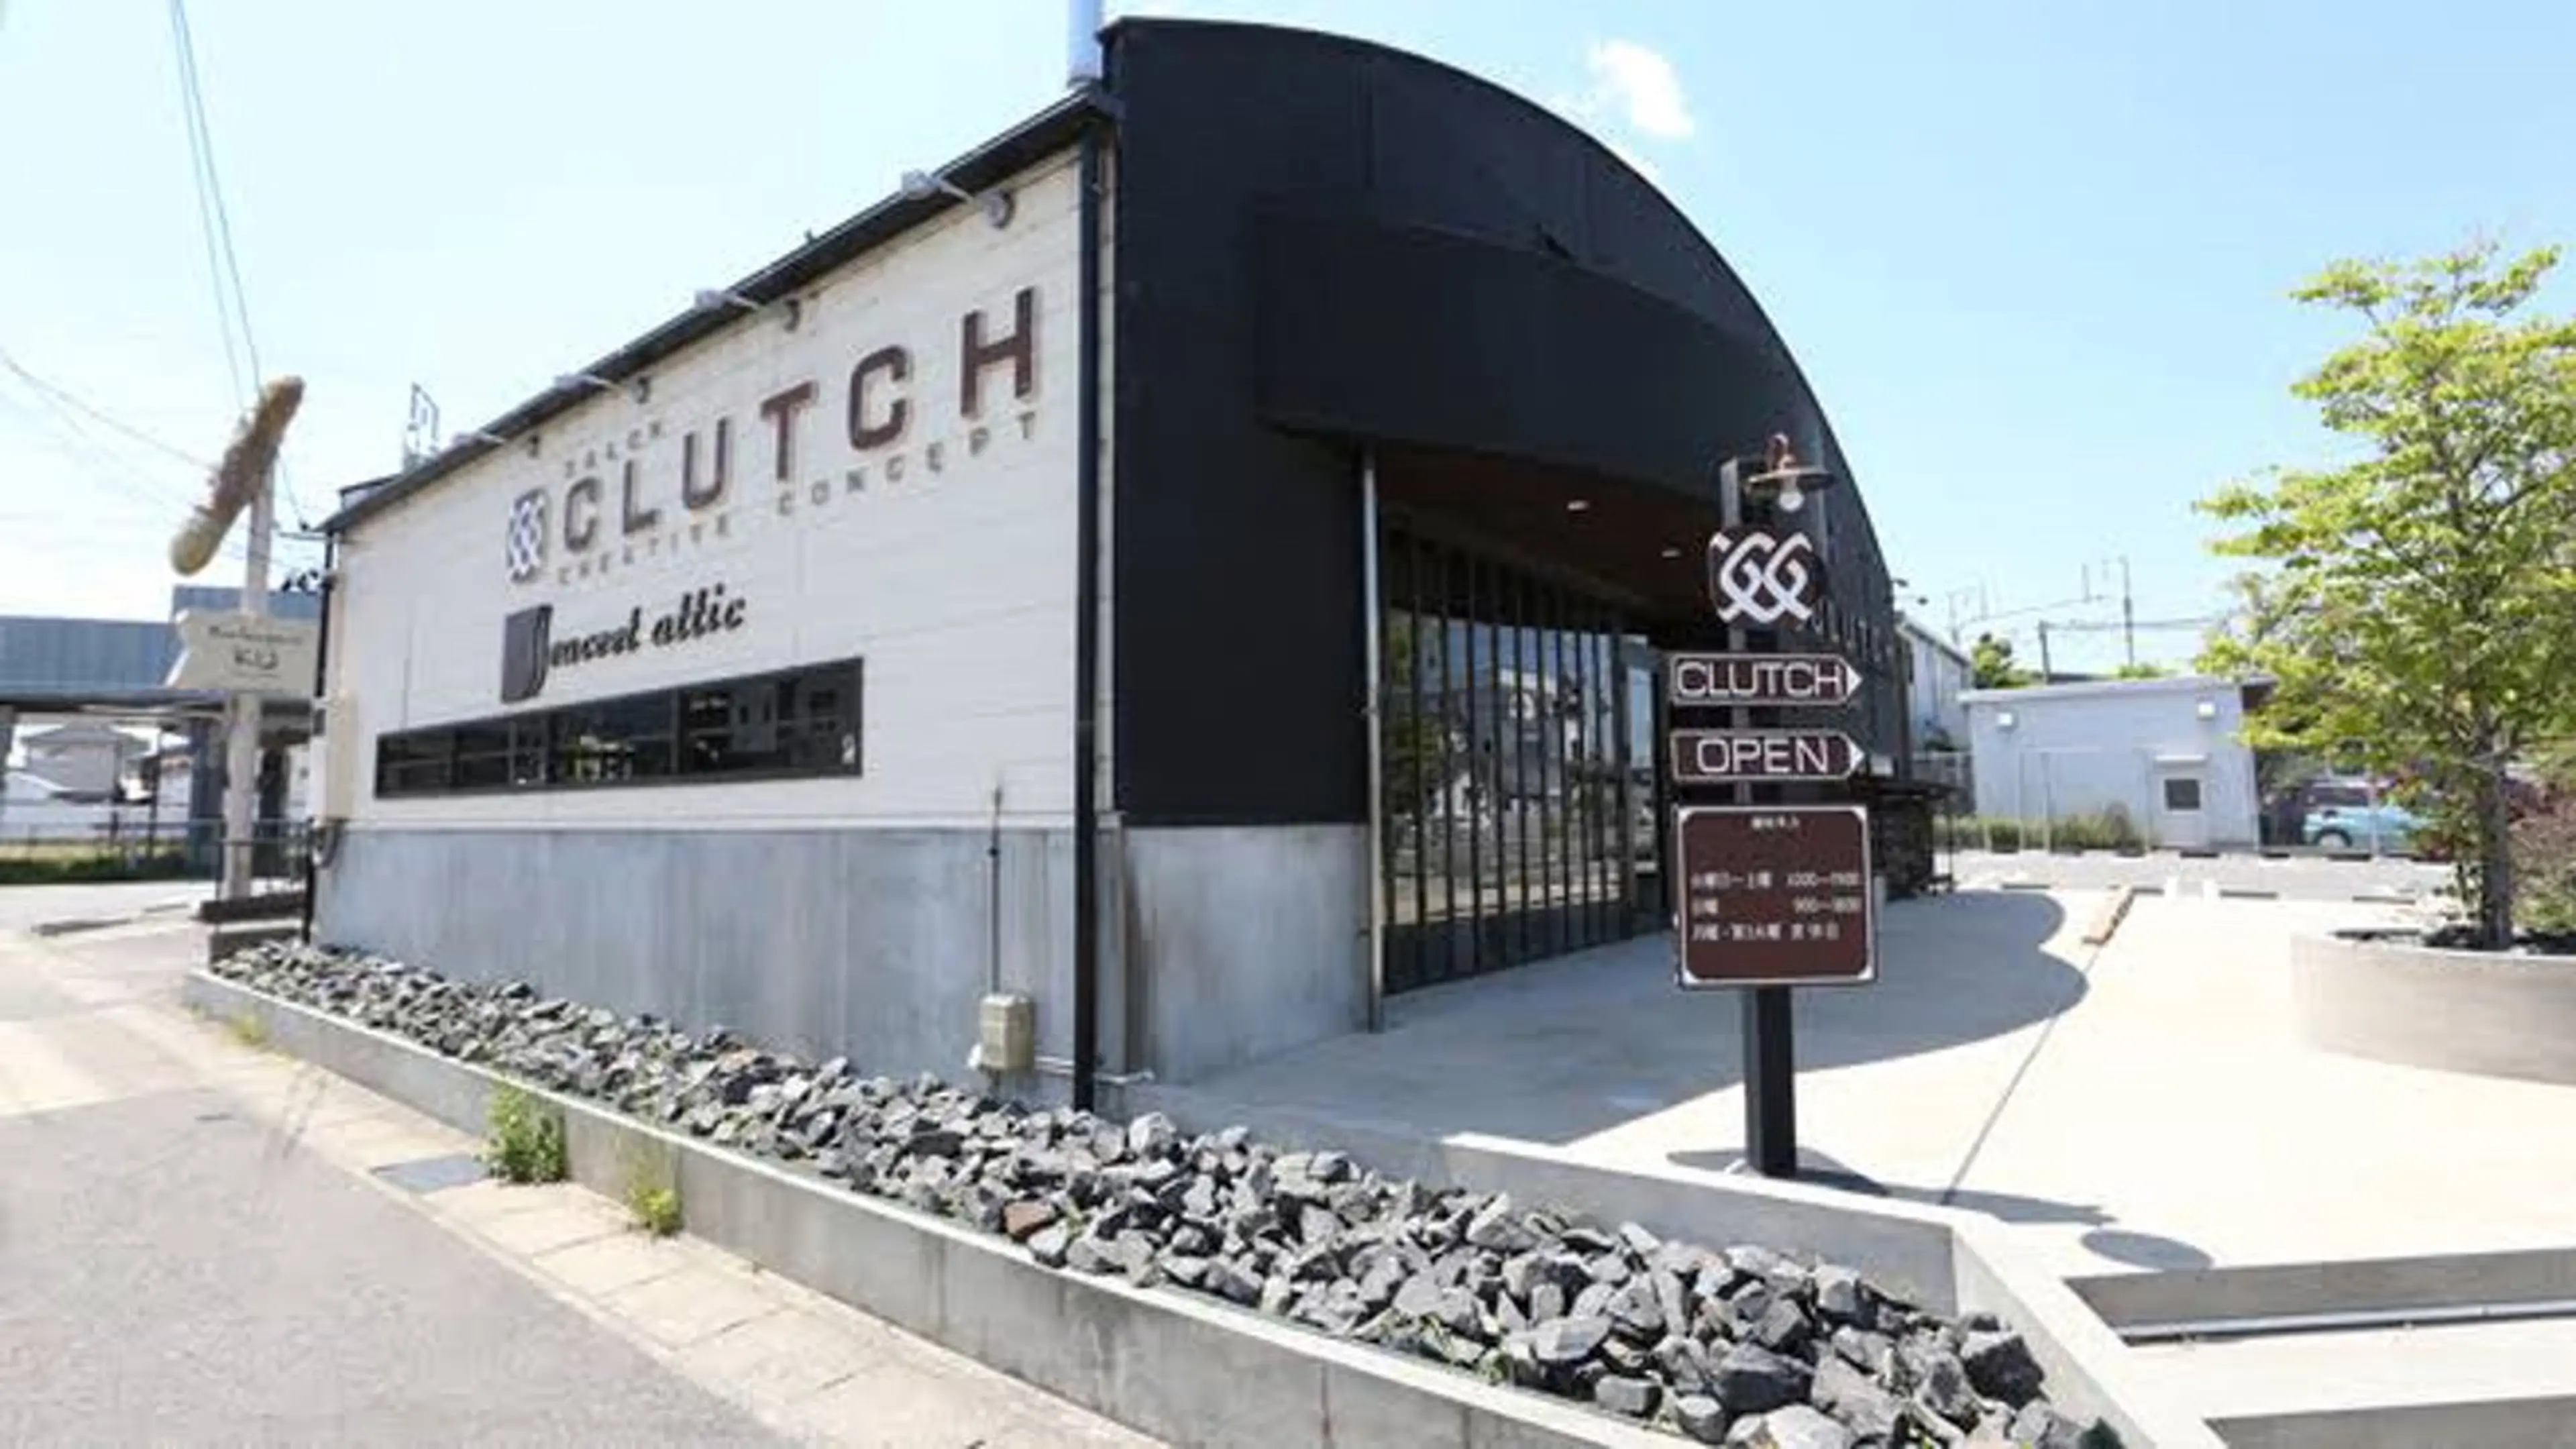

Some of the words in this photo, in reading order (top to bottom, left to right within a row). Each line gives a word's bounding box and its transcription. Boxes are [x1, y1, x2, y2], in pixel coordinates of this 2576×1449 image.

[564, 285, 1040, 552] CLUTCH
[777, 410, 1036, 516] CONCEPT
[1677, 661, 1842, 697] CLUTCH
[1697, 739, 1829, 773] OPEN
